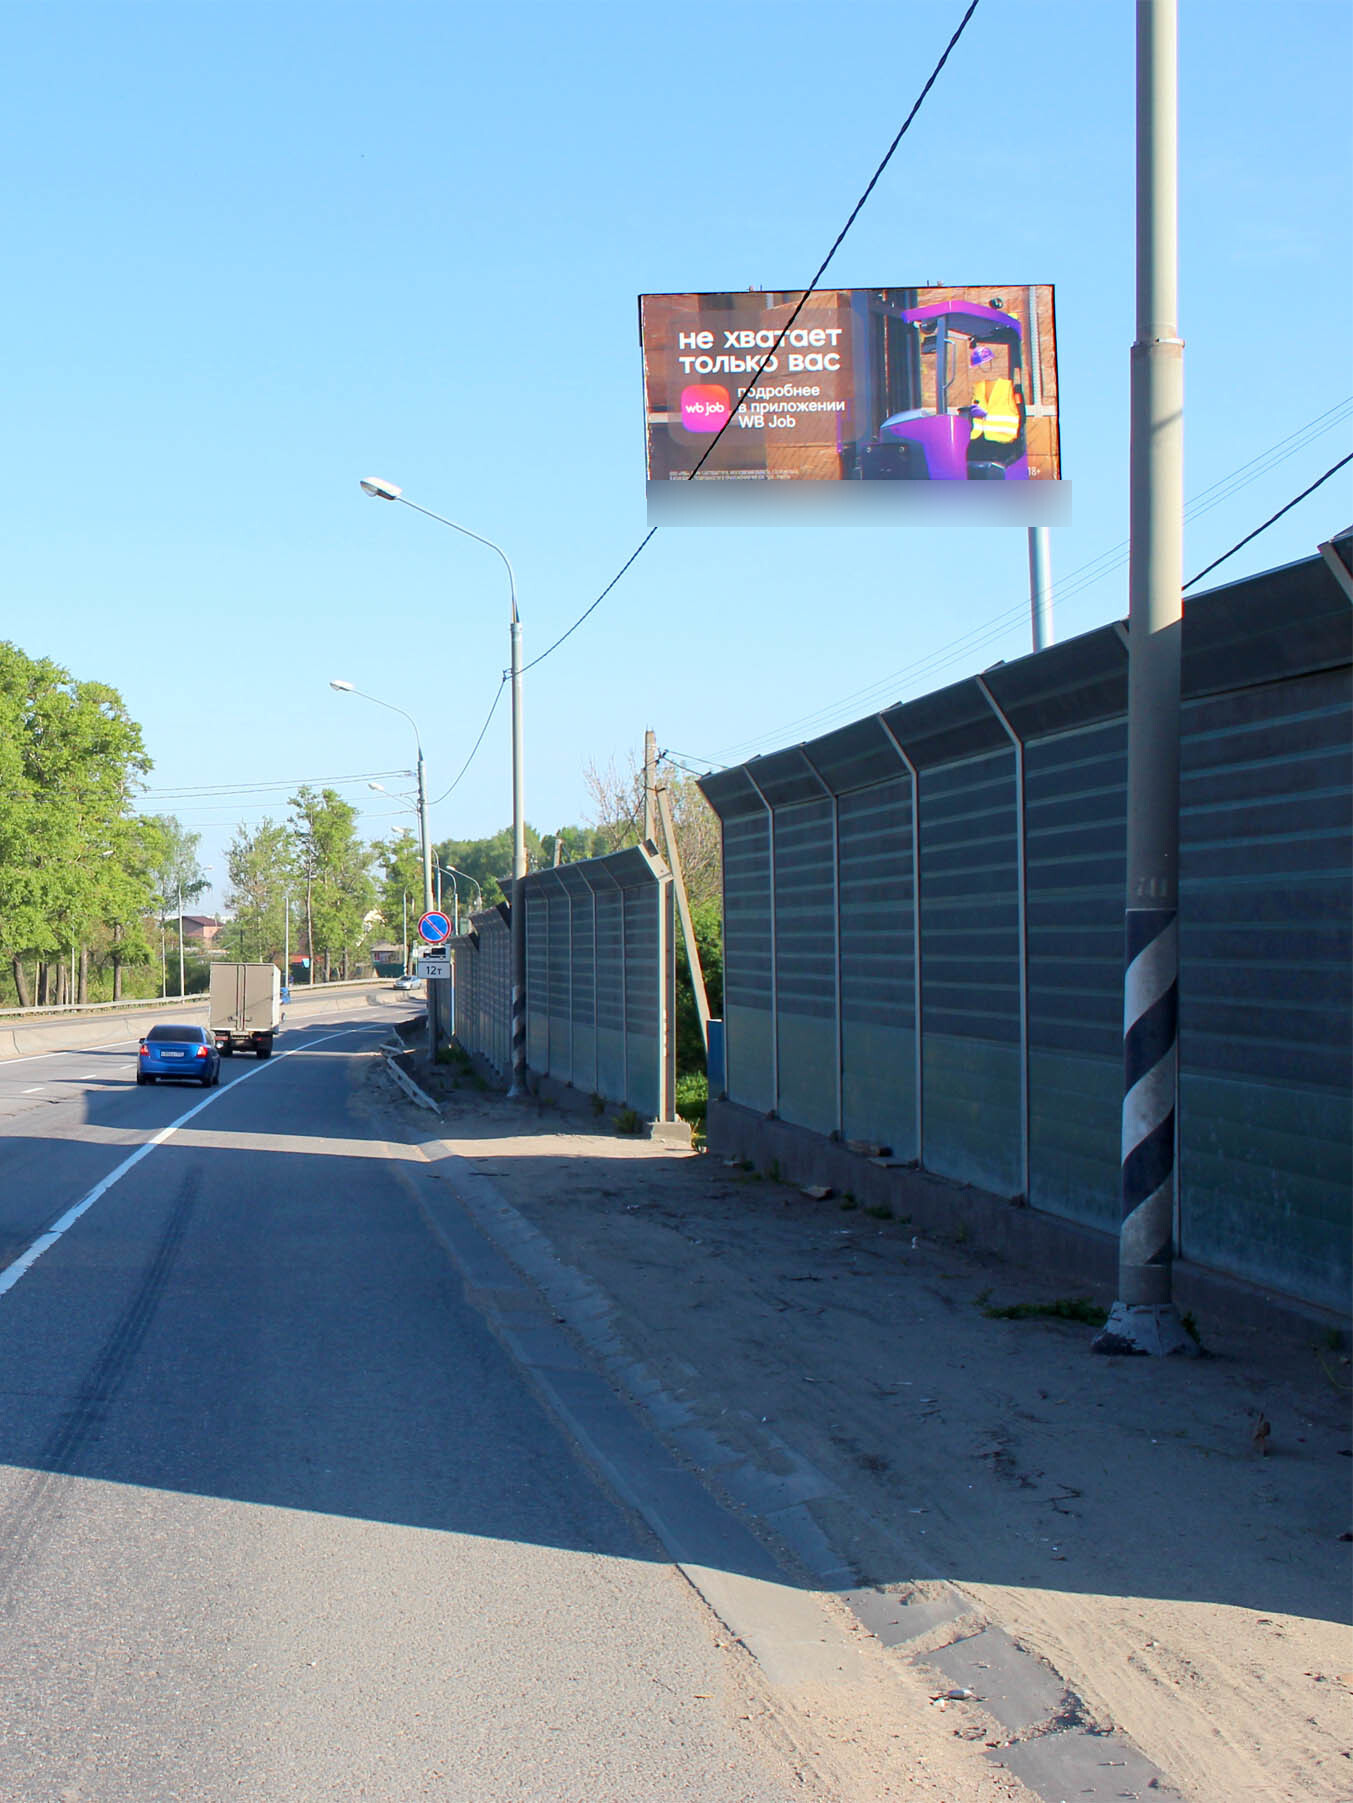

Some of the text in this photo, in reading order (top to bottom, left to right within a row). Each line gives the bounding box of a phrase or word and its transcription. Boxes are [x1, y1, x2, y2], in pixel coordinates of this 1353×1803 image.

[678, 328, 842, 349] не хватает
[679, 352, 841, 374] только вас
[737, 384, 820, 400] подробнее
[705, 401, 725, 416] job
[737, 400, 846, 415] в приложении
[738, 415, 796, 428] WB Job
[1027, 466, 1041, 477] 18+
